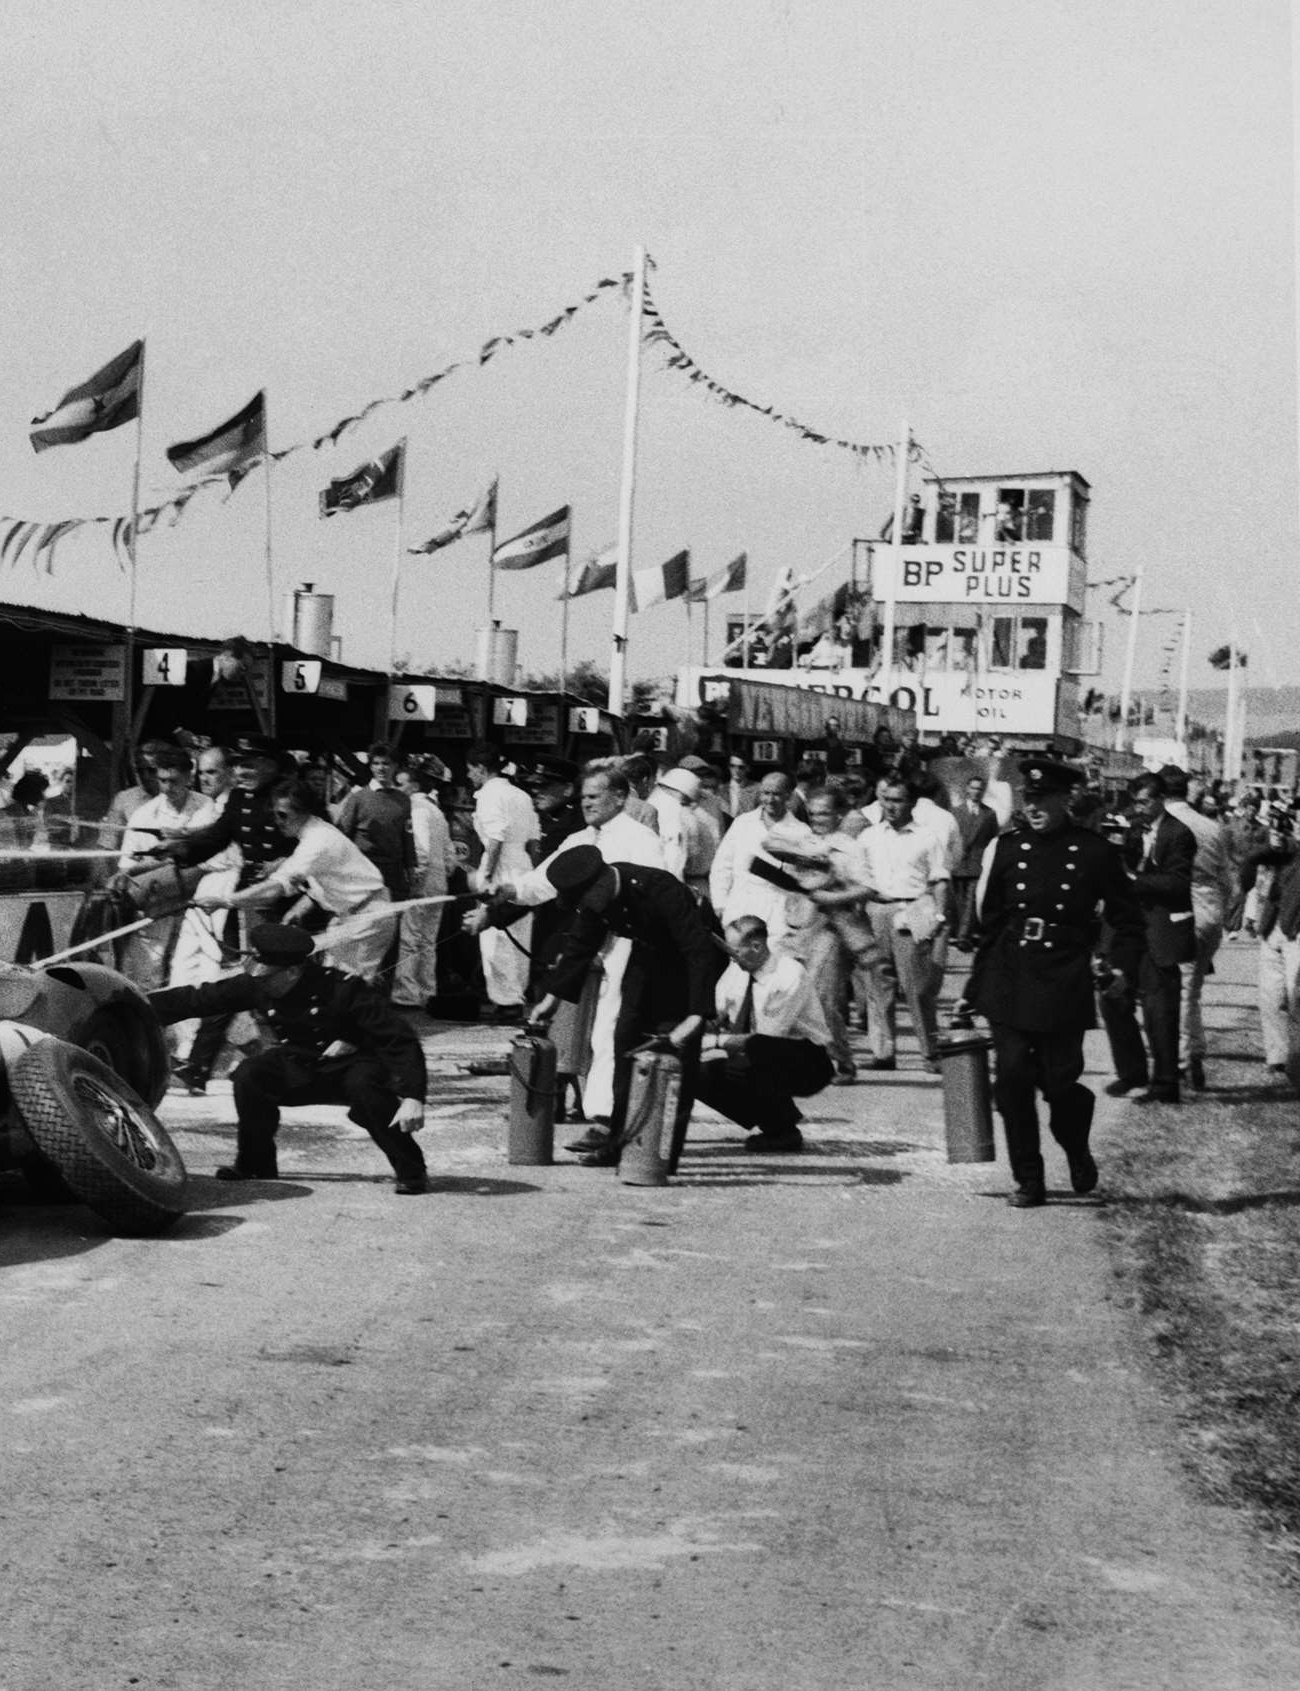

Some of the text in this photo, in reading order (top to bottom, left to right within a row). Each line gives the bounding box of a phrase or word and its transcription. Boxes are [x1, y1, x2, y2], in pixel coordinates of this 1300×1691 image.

[953, 550, 1041, 573] SUPER
[903, 560, 944, 587] BP
[966, 575, 1031, 598] PLUS
[157, 652, 170, 682] 4
[294, 663, 306, 691] 5
[403, 692, 418, 714] 6
[506, 700, 514, 723] 7
[976, 707, 1007, 719] OIL
